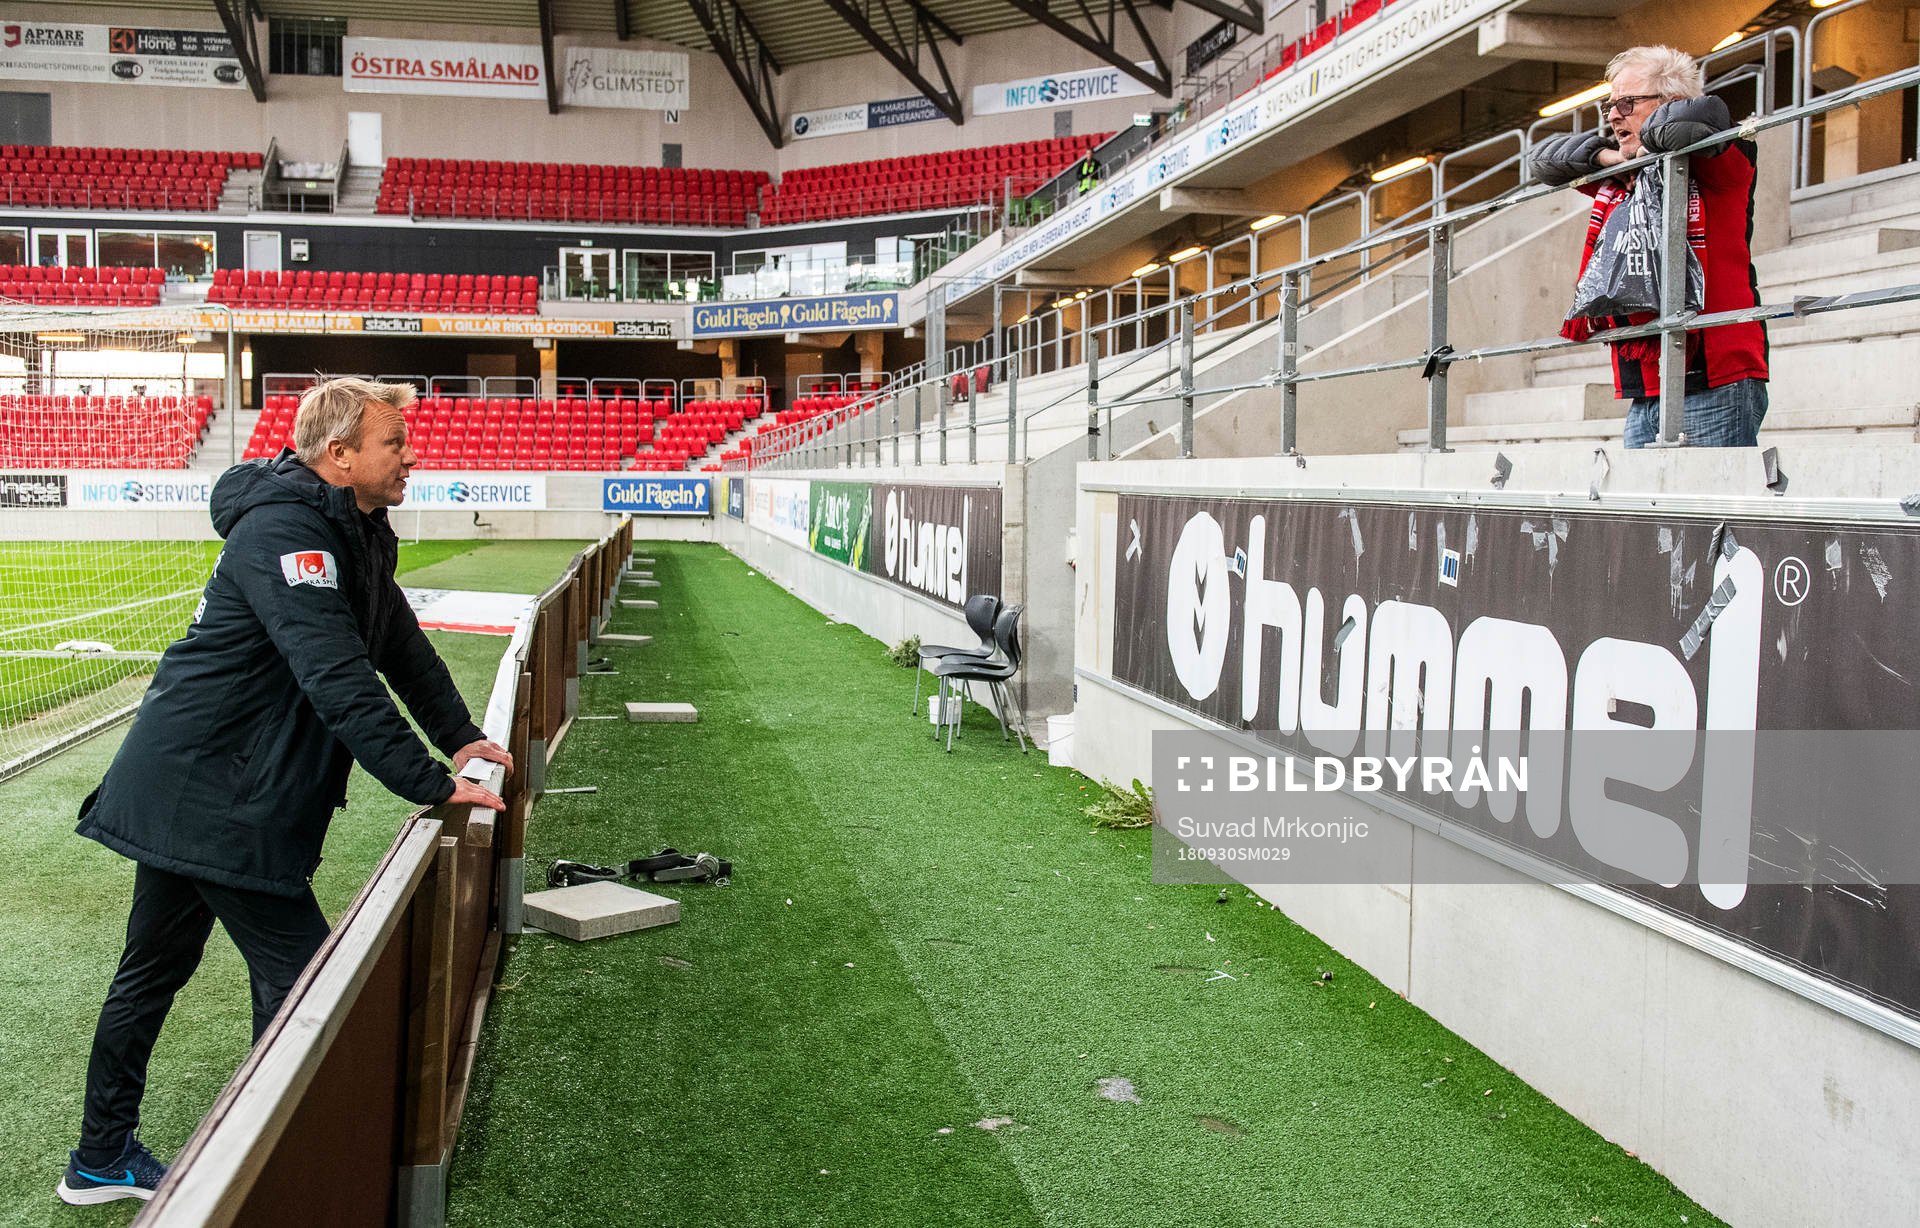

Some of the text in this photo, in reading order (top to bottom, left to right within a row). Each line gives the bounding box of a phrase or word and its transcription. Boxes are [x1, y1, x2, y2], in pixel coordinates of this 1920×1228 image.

[25, 28, 84, 41] APTARE
[25, 39, 84, 47] FASTIGHETER
[138, 35, 176, 50] Home
[351, 52, 539, 80] ÖSTRA SMÅLAND
[593, 76, 685, 94] GLIMSTEDT
[1006, 74, 1118, 107] INFO SERVICE
[872, 101, 905, 114] KALMARS
[1266, 84, 1307, 118] SVENSK
[667, 110, 679, 123] N
[879, 109, 936, 125] IT-LEVERANTÖR
[1229, 105, 1259, 142] SERVICE
[1166, 145, 1190, 178] SERVICE
[1115, 179, 1136, 205] SERVICE
[1689, 178, 1700, 222] SWEDEN
[1627, 253, 1652, 276] EEL
[212, 316, 225, 327] VI
[278, 316, 334, 329] KALMAR
[366, 318, 421, 331] stadium
[697, 298, 881, 331] Guld Fågeln Guld Fågeln
[439, 319, 452, 331] VI
[455, 320, 500, 332] GILLAR
[503, 321, 544, 333] RIKTIG
[616, 322, 668, 336] stadium
[83, 484, 209, 502] INFO SERVICE
[412, 484, 532, 503] INFO SERVICE
[608, 480, 694, 509] Guld Fågeln
[899, 490, 969, 606] hummel
[289, 577, 321, 585] SVSKA
[1242, 514, 1764, 910] hummel
